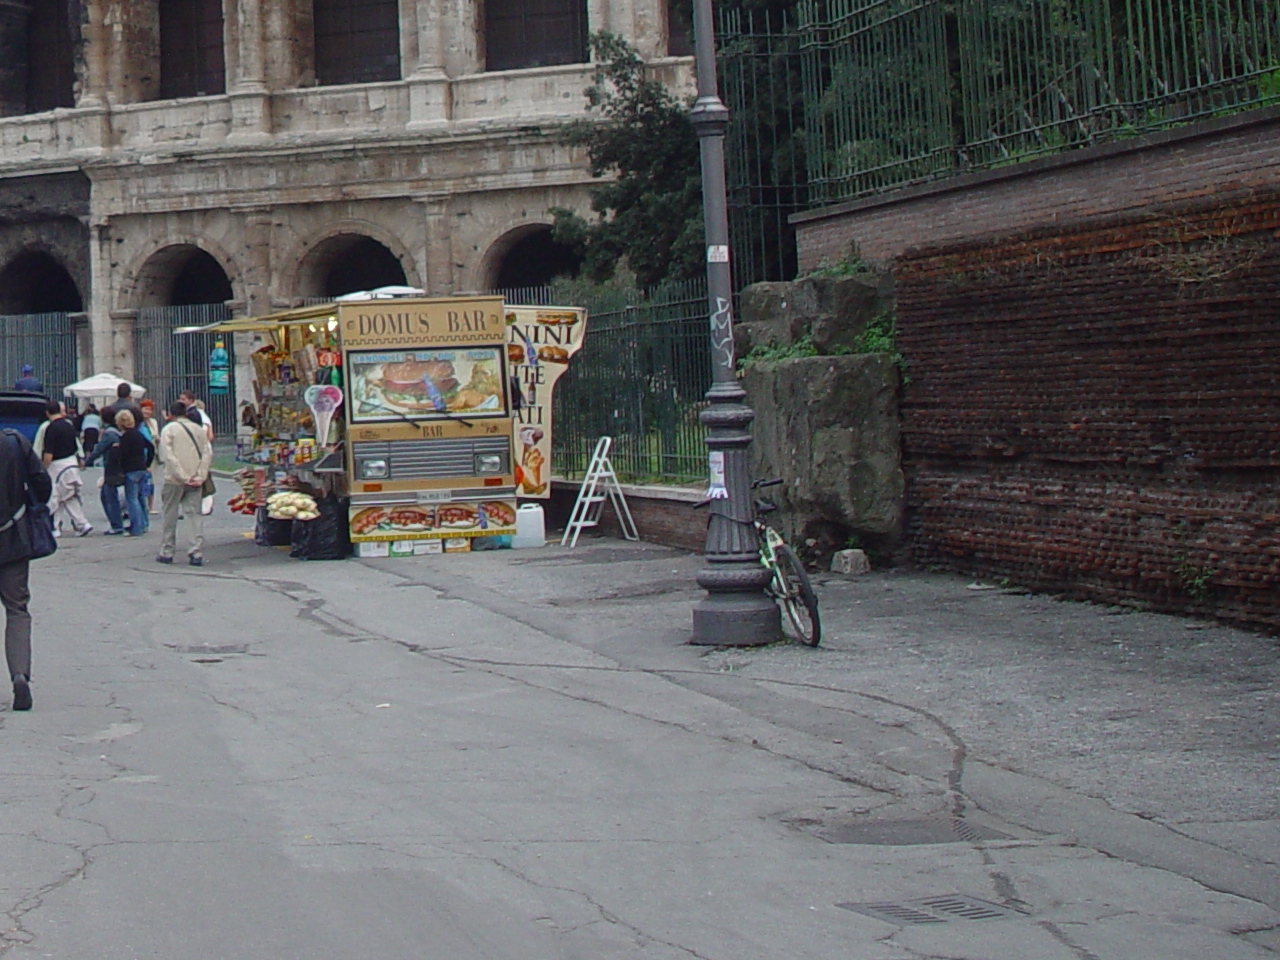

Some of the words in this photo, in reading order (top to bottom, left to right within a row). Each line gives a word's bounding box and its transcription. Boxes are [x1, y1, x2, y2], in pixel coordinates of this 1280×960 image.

[358, 312, 430, 336] DOMUS
[447, 309, 487, 333] BAR
[510, 324, 573, 345] NINI
[437, 351, 456, 361] DOG
[422, 425, 443, 438] BAR
